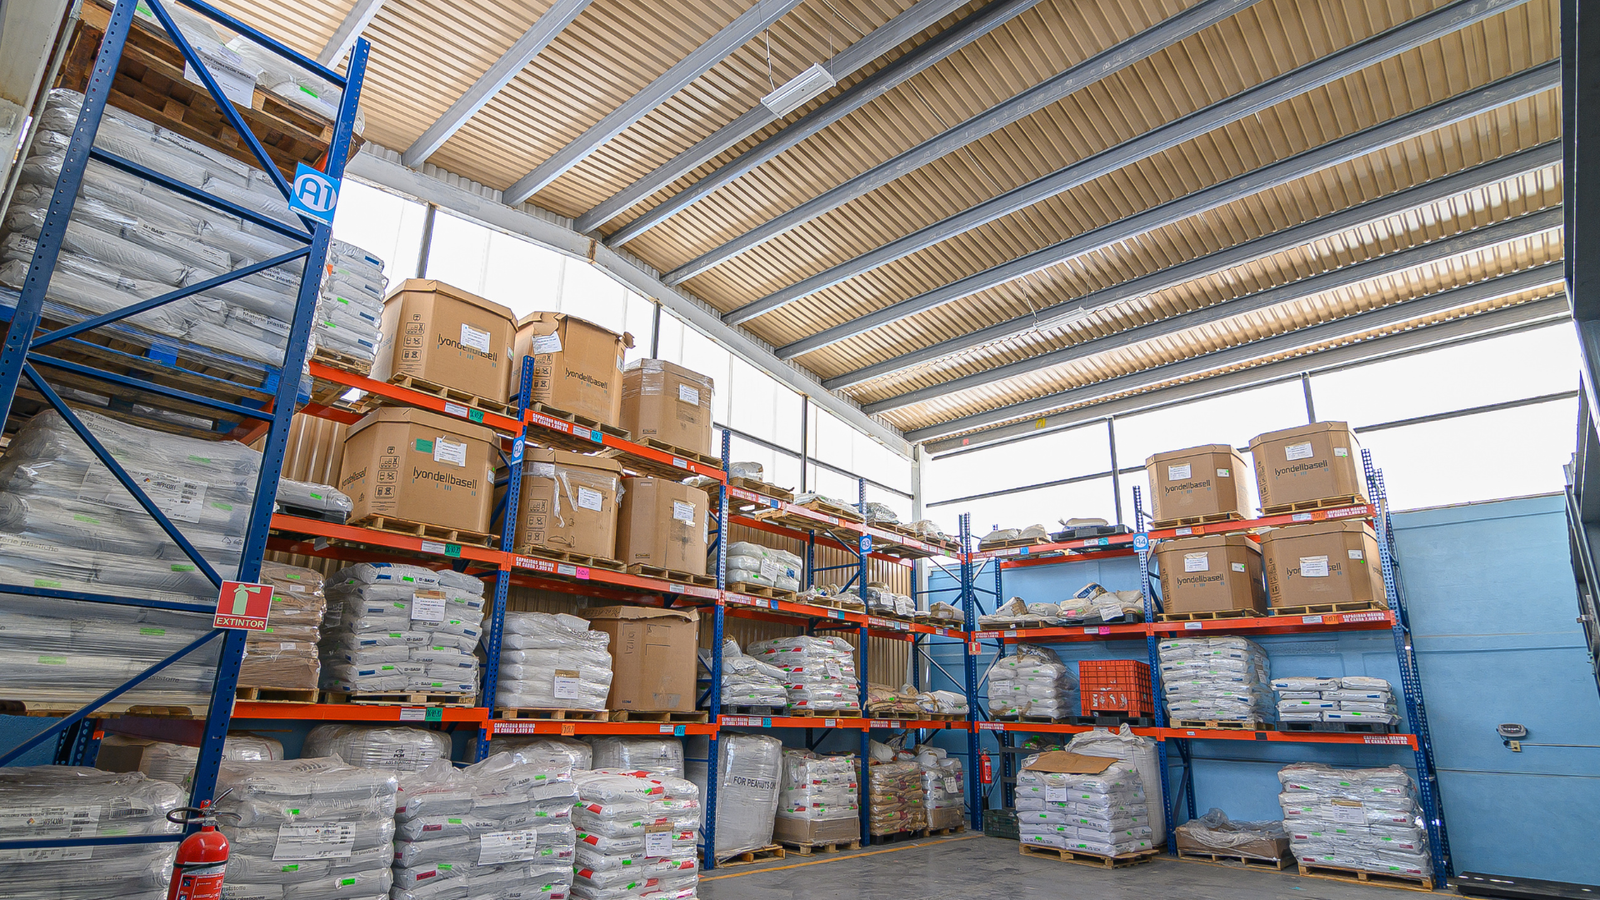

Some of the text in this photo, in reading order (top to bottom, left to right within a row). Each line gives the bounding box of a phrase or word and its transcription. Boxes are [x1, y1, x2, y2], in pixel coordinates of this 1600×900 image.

[299, 177, 333, 210] A1
[438, 333, 498, 361] lyonebsell
[565, 367, 607, 389] lyondellbasell
[1275, 459, 1328, 477] lyondellbasell
[413, 466, 477, 490] lyondellbasell
[1165, 479, 1211, 494] lyondellbasell
[1286, 562, 1341, 577] lyonsell
[1176, 573, 1224, 586] lyondellbasell
[216, 617, 264, 628] EXTINTOR
[733, 775, 746, 786] FOR
[747, 778, 769, 790] PEANUTS
